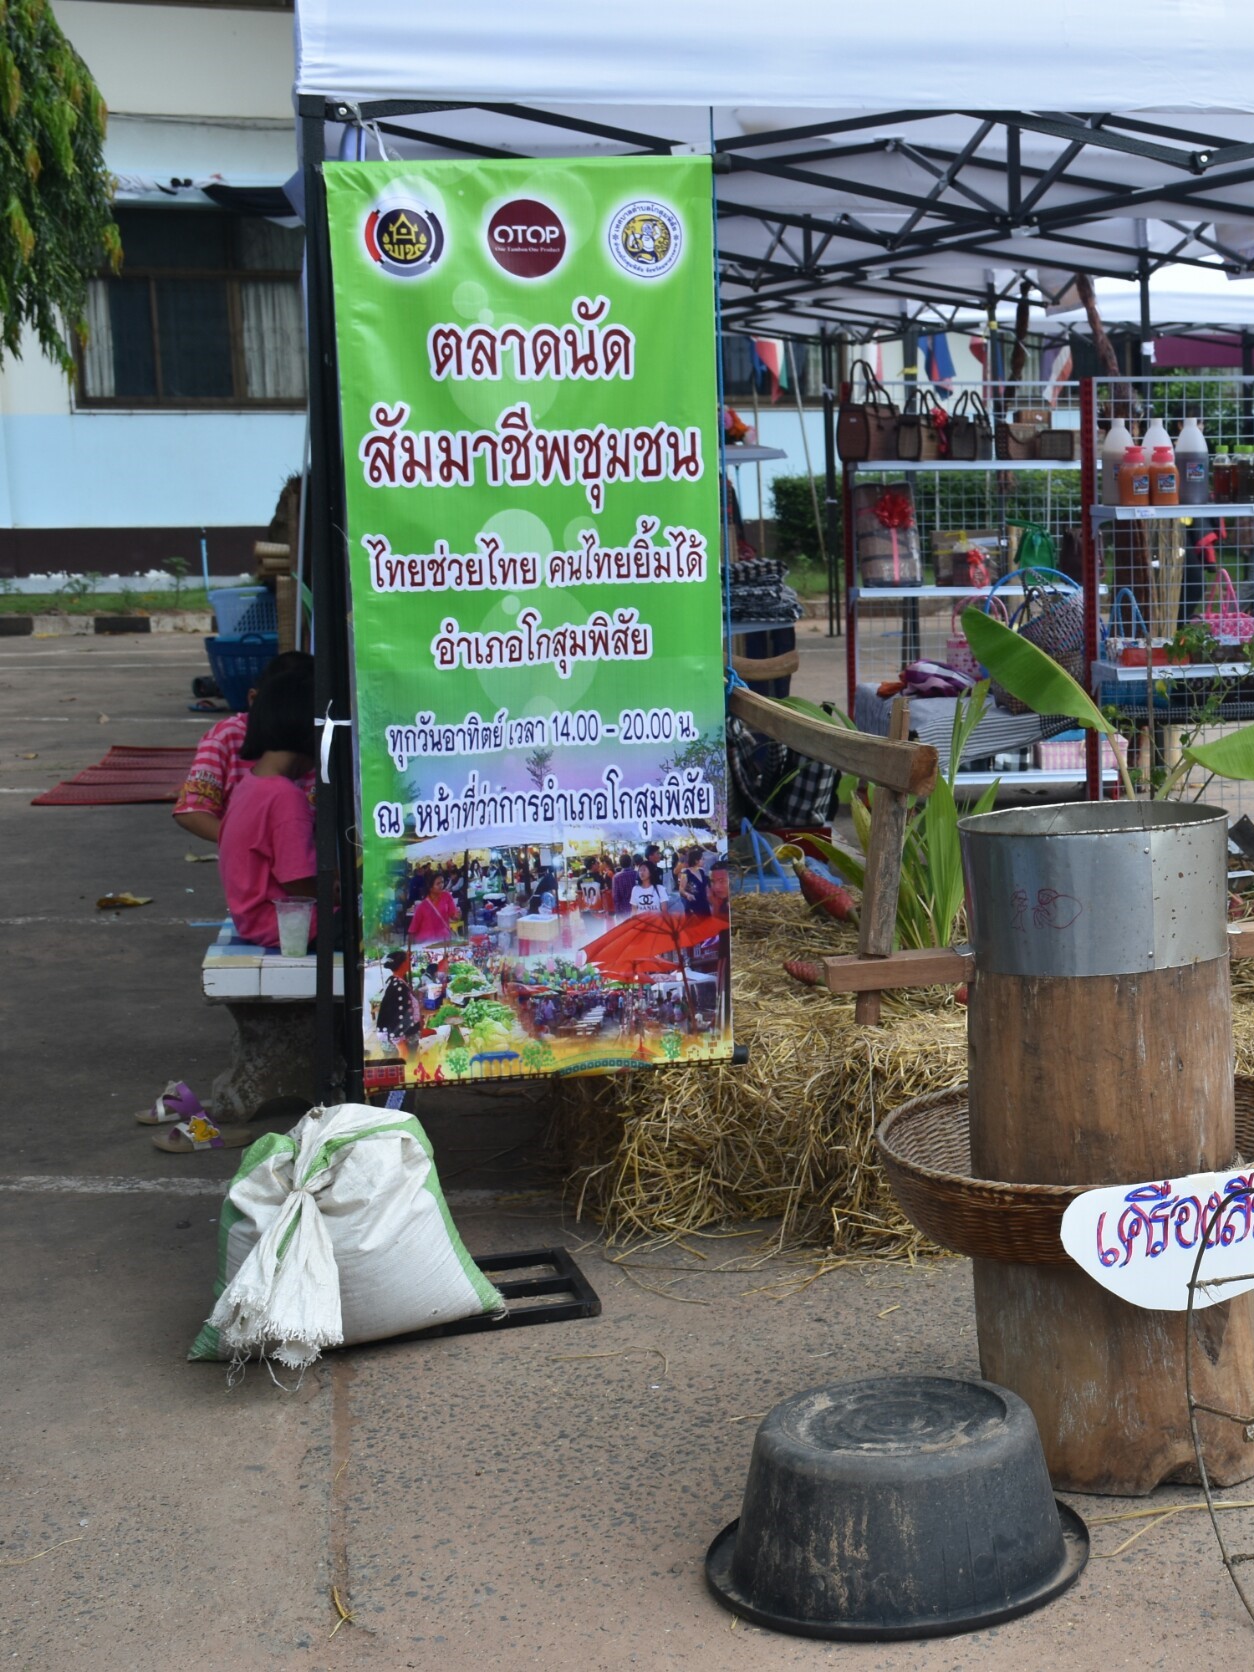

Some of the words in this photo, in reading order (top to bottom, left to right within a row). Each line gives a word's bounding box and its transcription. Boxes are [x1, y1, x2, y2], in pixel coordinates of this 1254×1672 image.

[493, 225, 560, 244] OTOP
[430, 298, 633, 379] ตลาดนัด
[363, 405, 701, 510] สัมมาชีพชุมชน
[367, 537, 537, 590] ไทยช่วยไทย
[549, 518, 705, 585] คนไทยยิ้มได้
[435, 611, 650, 675] อำเภอโกสุมพิสัย
[388, 710, 506, 770] ทุกวันอาทิตย์
[508, 718, 545, 748] เวลา
[552, 715, 598, 742] 14.00
[622, 713, 672, 739] 20.00
[374, 800, 402, 836] ณ
[416, 771, 713, 837] หน้าที่ว่าการอำเภอโกสุมพิสัย
